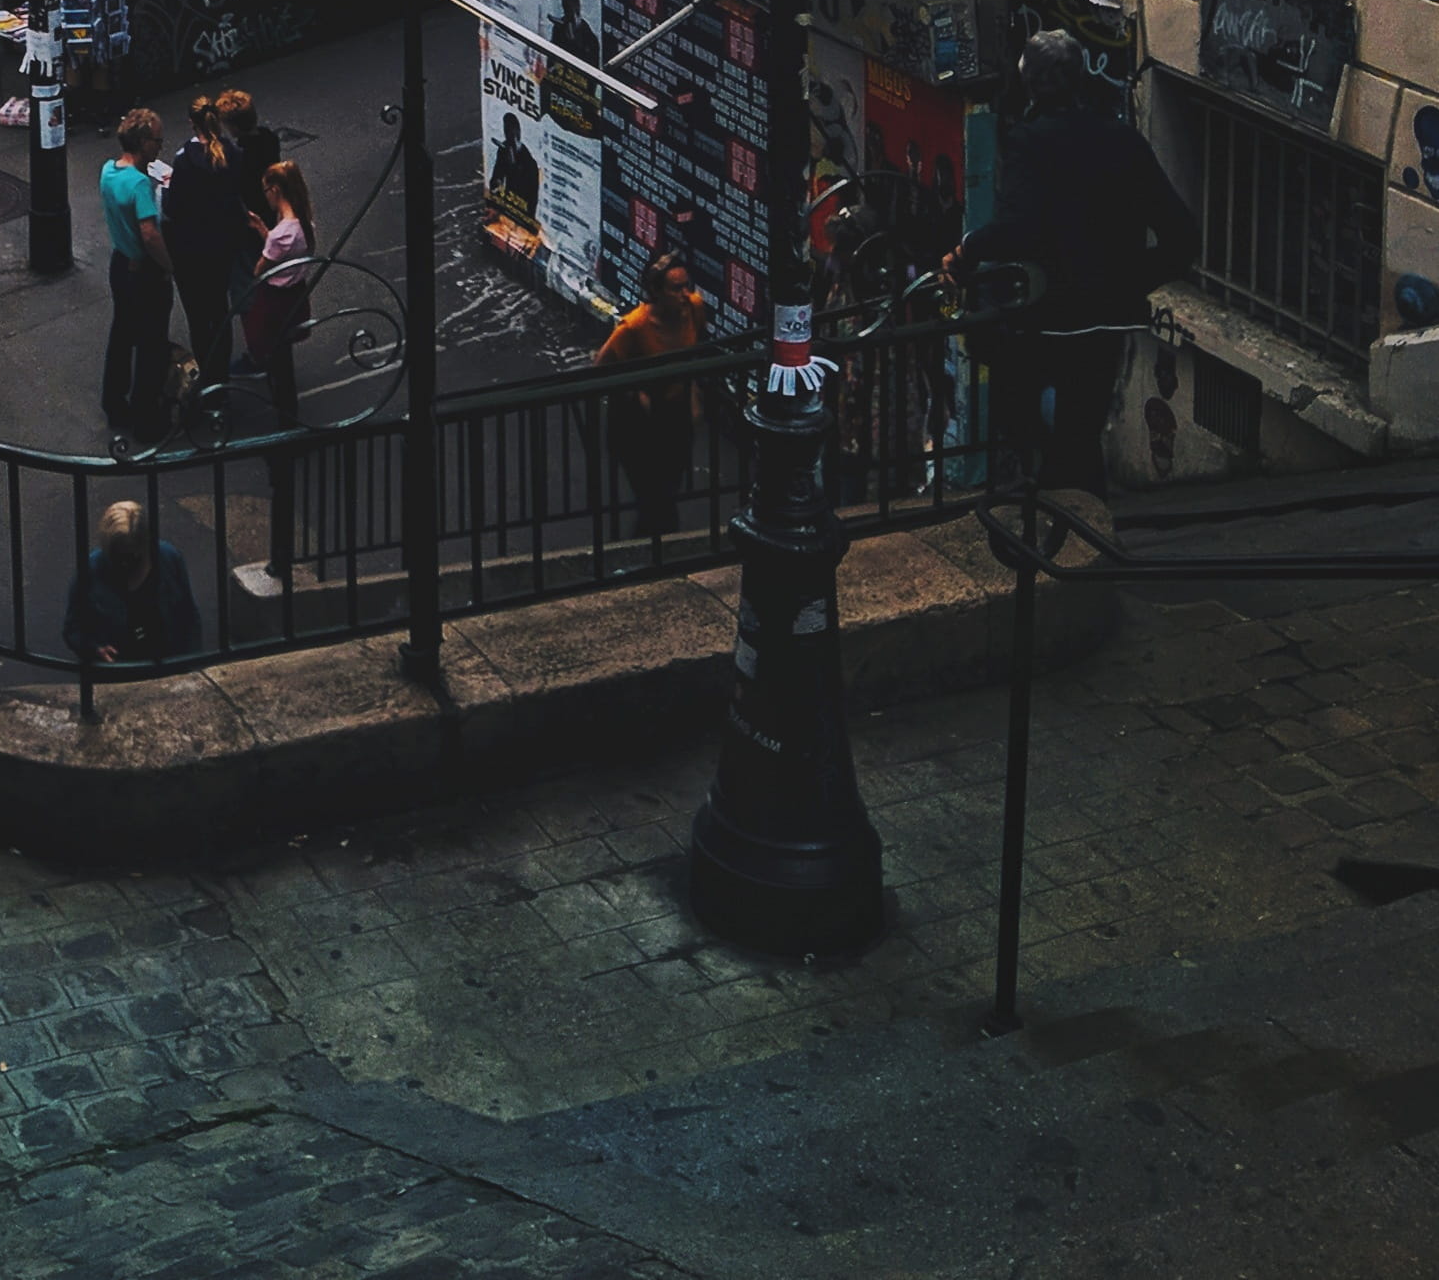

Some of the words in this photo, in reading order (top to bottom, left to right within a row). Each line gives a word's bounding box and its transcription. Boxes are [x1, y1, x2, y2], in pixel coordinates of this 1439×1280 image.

[483, 77, 541, 122] STAPLES
[490, 58, 535, 100] VINCE
[550, 92, 584, 116] PARIS
